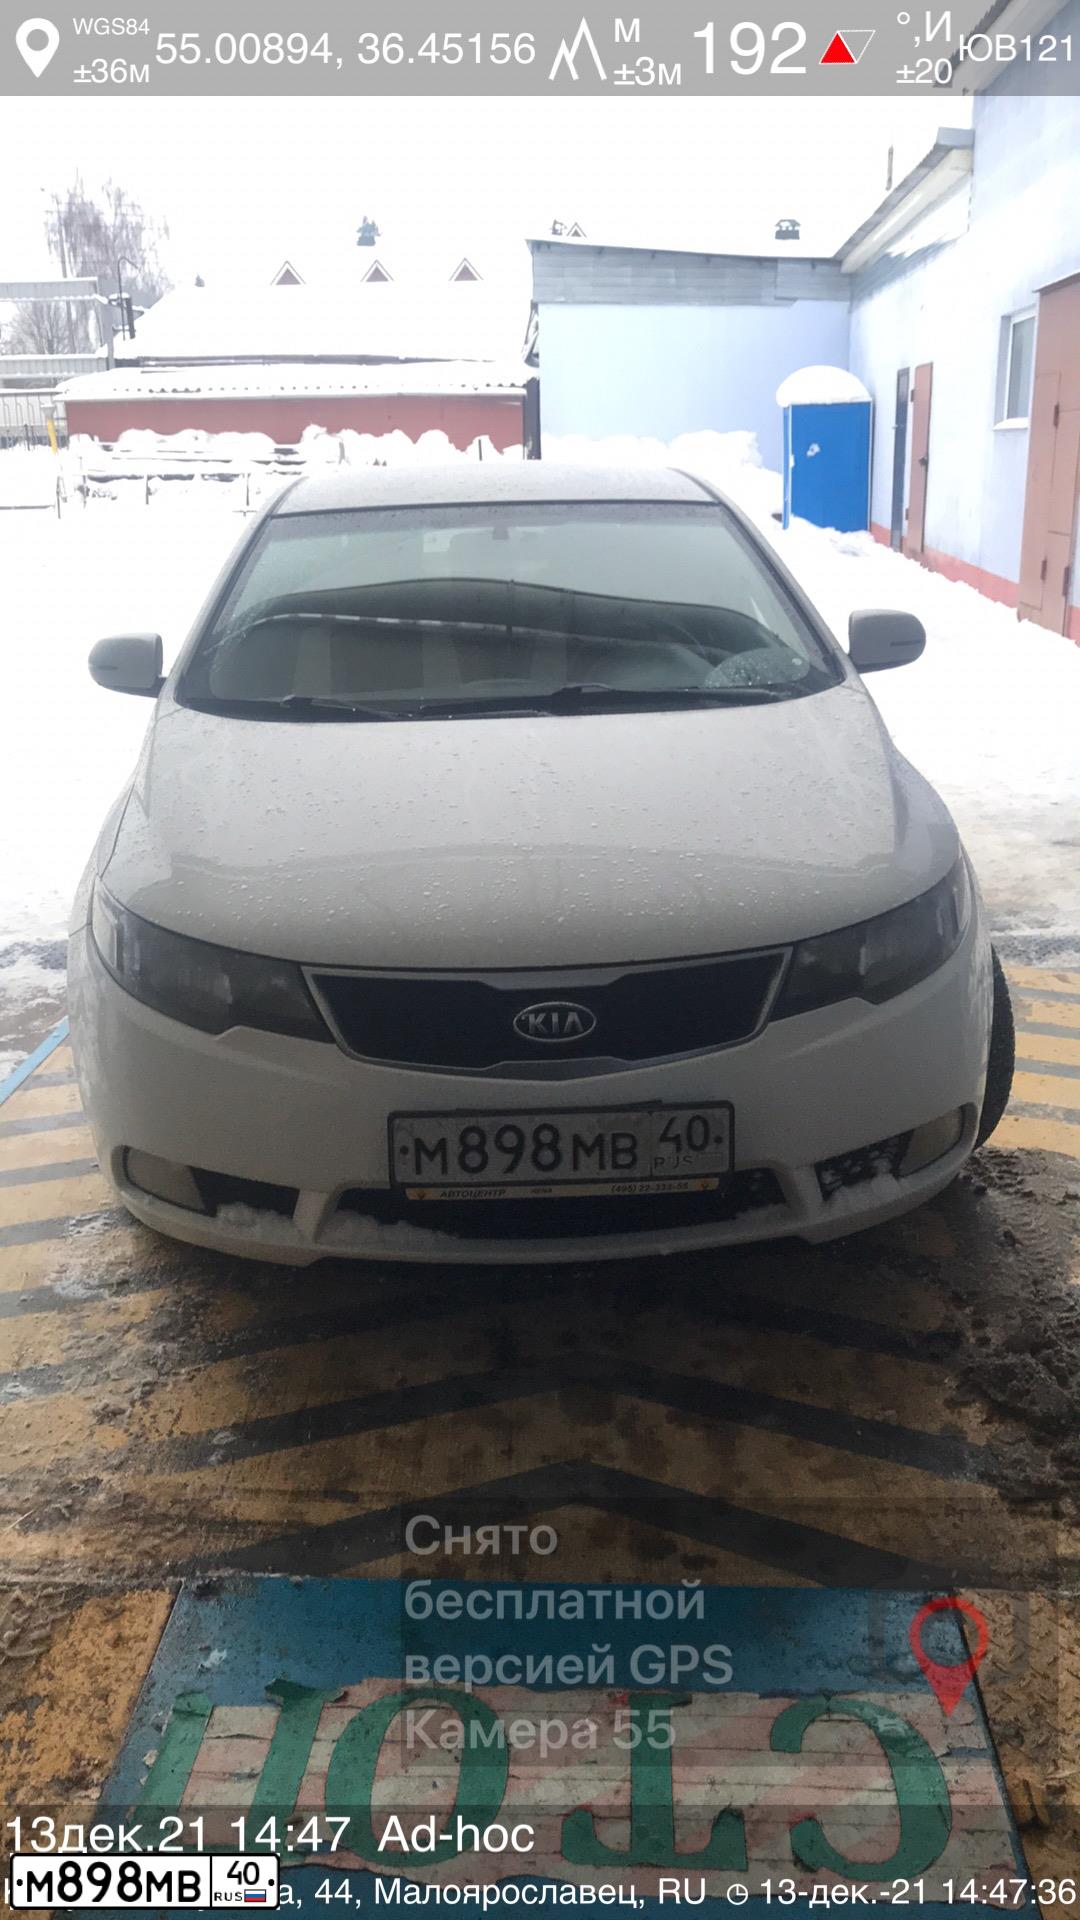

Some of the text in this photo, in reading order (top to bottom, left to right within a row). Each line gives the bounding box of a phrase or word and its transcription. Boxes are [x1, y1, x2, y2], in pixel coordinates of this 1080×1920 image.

[528, 1011, 584, 1033] KIA
[413, 1114, 710, 1176] М898МВ 40
[440, 1188, 507, 1199] АВТОЦЕНТР
[125, 1679, 953, 1882] СТОП
